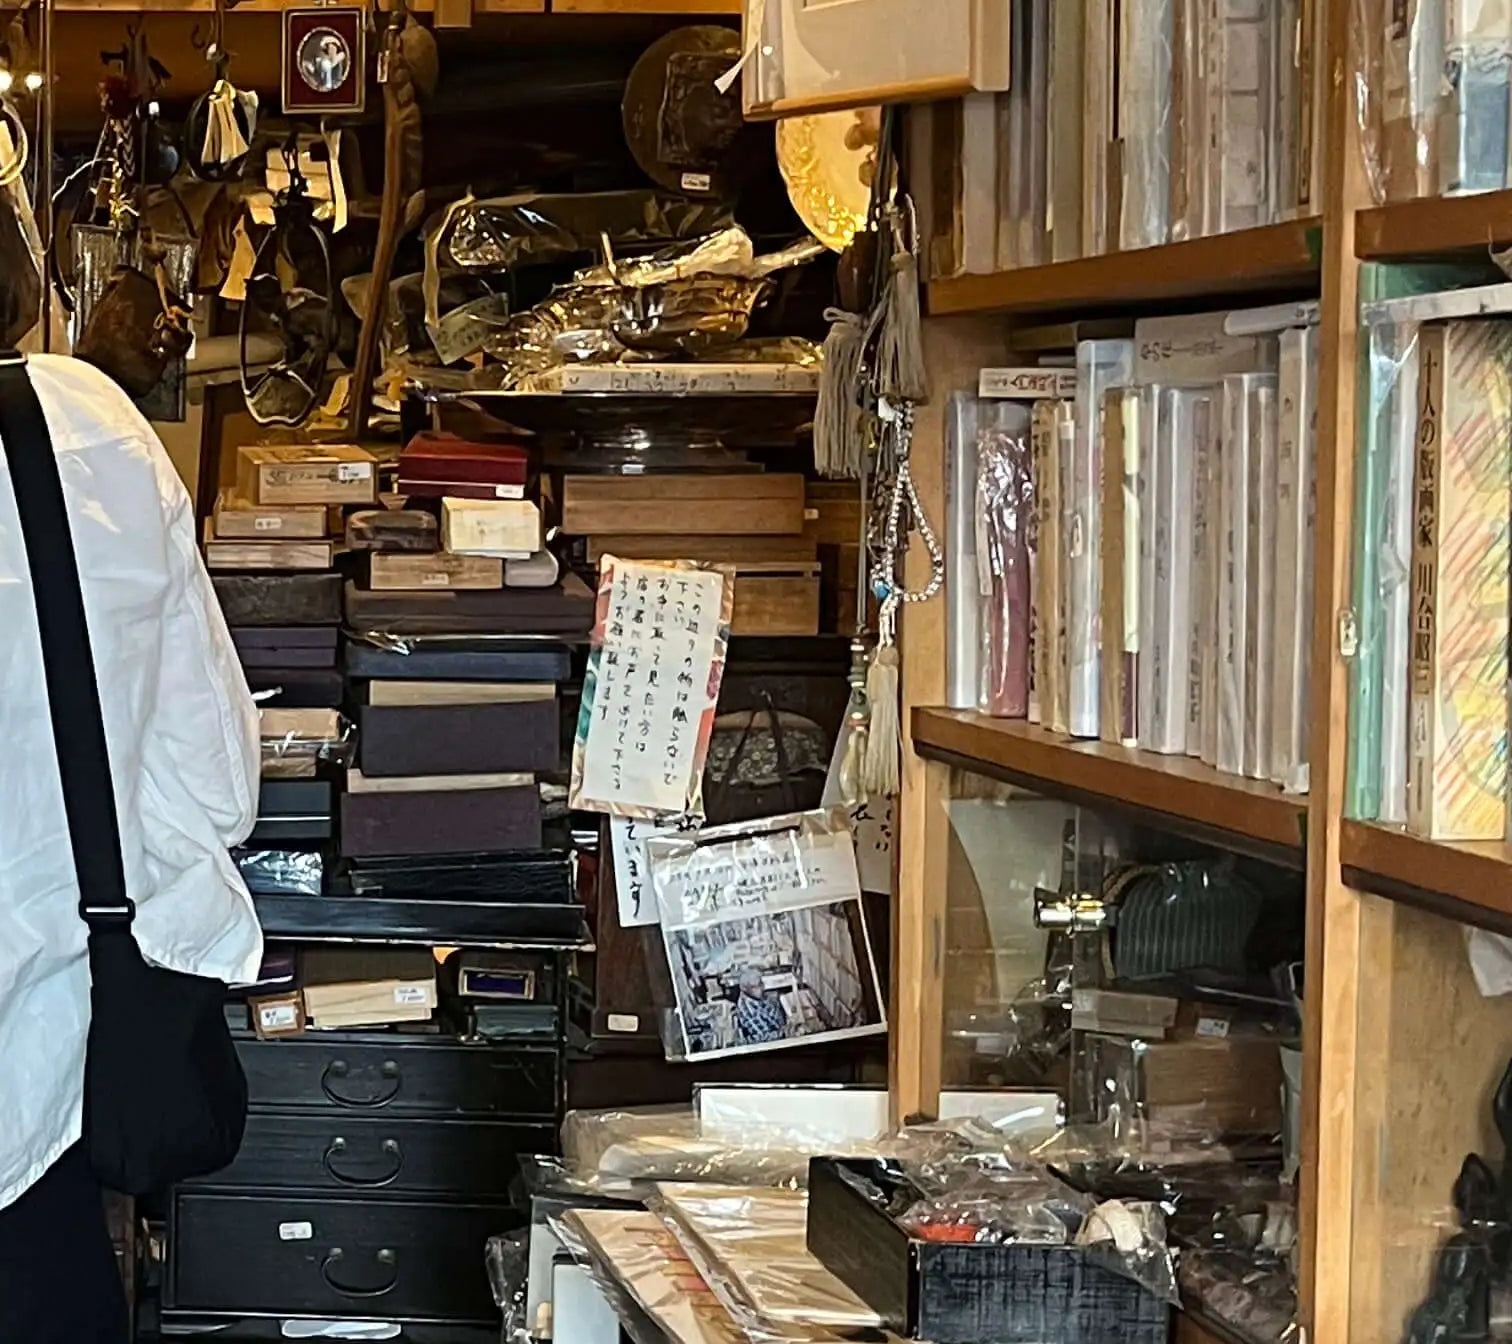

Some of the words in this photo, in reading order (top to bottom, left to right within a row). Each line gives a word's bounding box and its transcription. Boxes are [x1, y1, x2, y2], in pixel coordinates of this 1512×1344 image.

[674, 580, 689, 625] 下さい
[620, 816, 643, 919] ています
